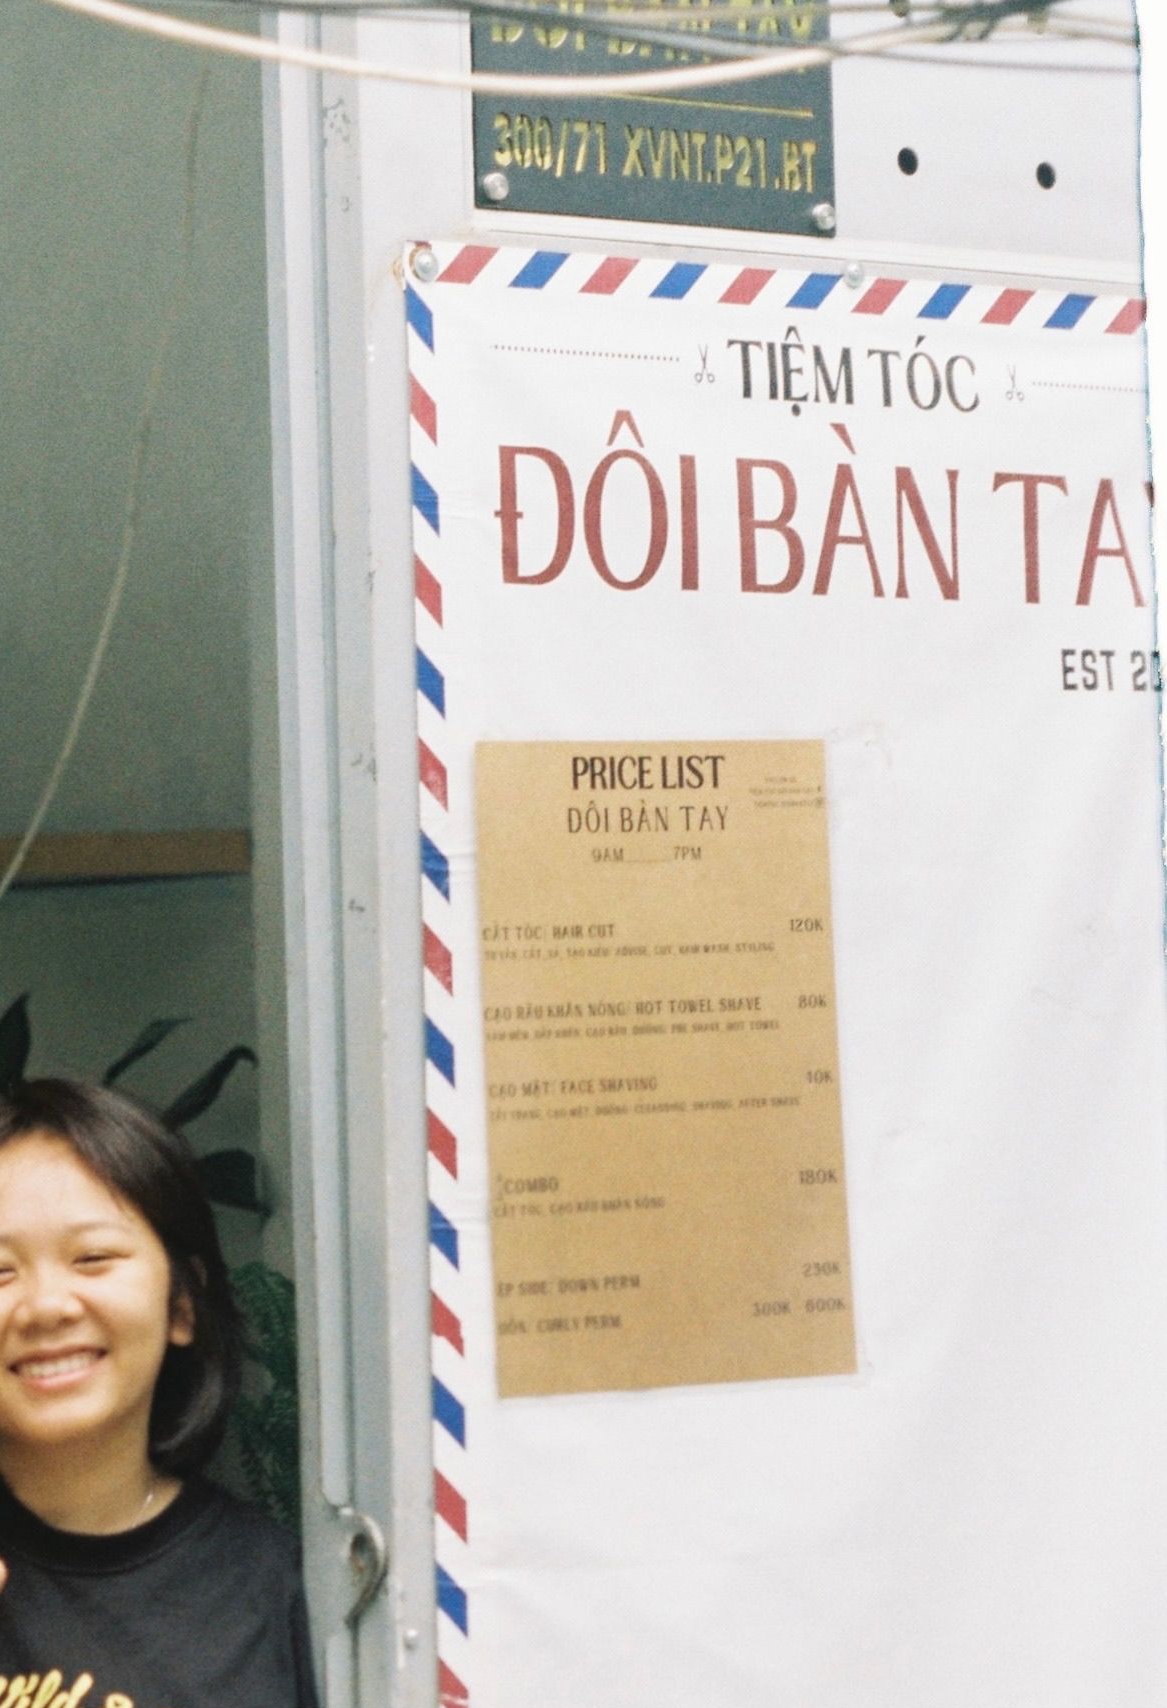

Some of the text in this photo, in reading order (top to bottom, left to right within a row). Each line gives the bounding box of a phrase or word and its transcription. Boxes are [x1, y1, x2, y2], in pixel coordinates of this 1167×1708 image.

[493, 112, 608, 178] 300/71
[727, 326, 980, 417] TIỆM TÓC
[494, 409, 1156, 607] ĐÔI BÀN TA
[1061, 648, 1115, 692] EST
[571, 754, 725, 790] PRICE LIST
[620, 798, 668, 832] BÀN
[679, 804, 728, 832] TAY
[588, 922, 615, 938] CUT
[788, 918, 823, 933] 120K
[635, 999, 662, 1015] HOT
[669, 998, 715, 1014] TOWEL
[719, 996, 762, 1012] SHAVE
[798, 994, 827, 1010] 80K
[561, 1079, 594, 1094] FACE
[599, 1076, 657, 1093] SHAVING
[603, 1274, 640, 1291] PERM
